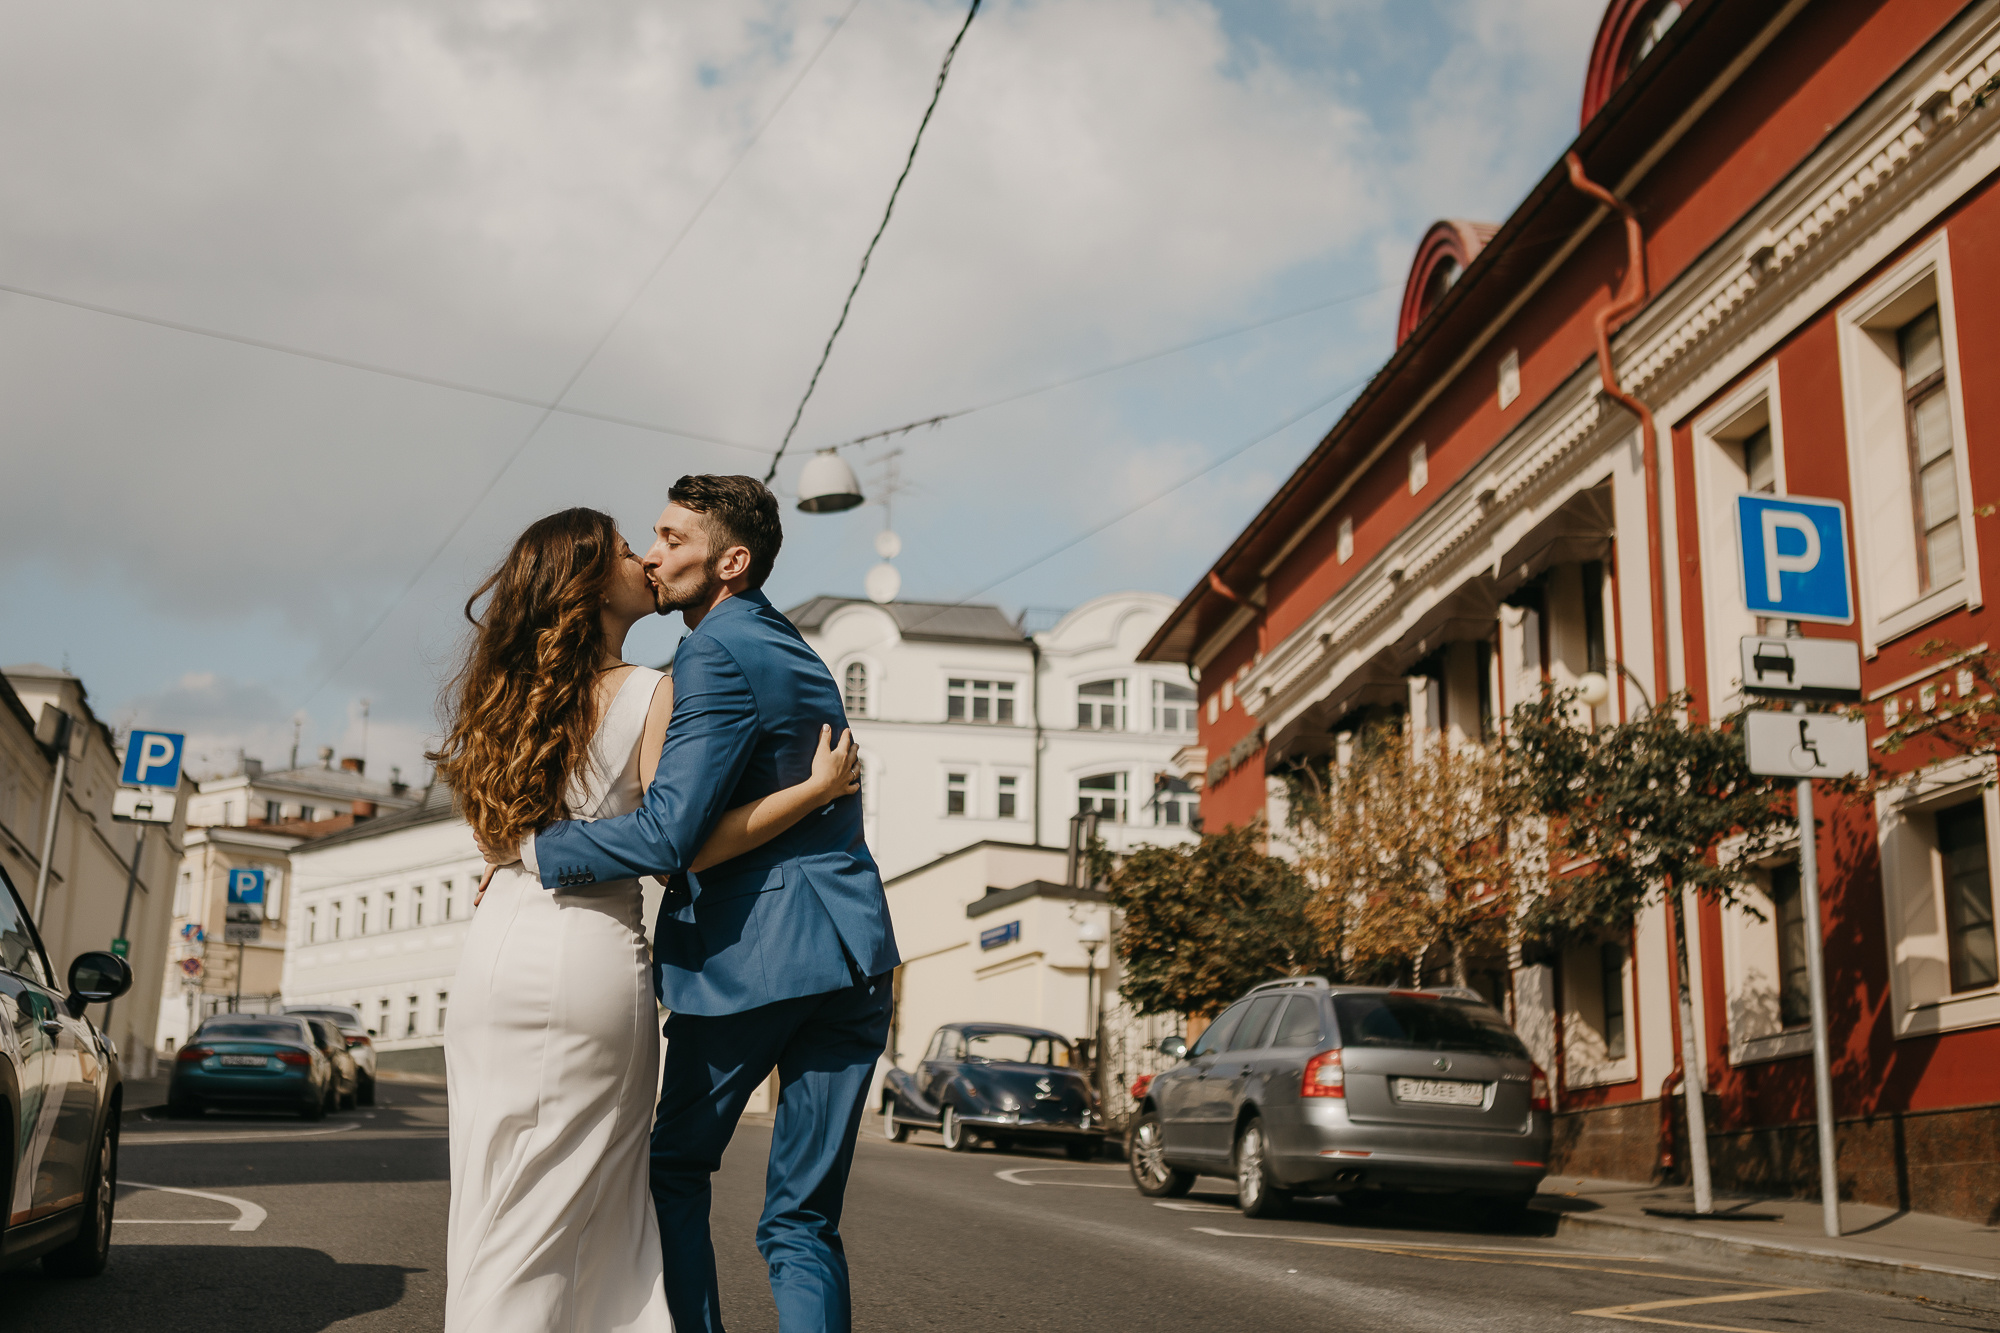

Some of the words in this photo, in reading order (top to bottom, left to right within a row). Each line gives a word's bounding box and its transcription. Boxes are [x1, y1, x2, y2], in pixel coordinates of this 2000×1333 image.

[1761, 508, 1821, 603] P
[136, 733, 175, 782] P
[236, 872, 258, 899] P
